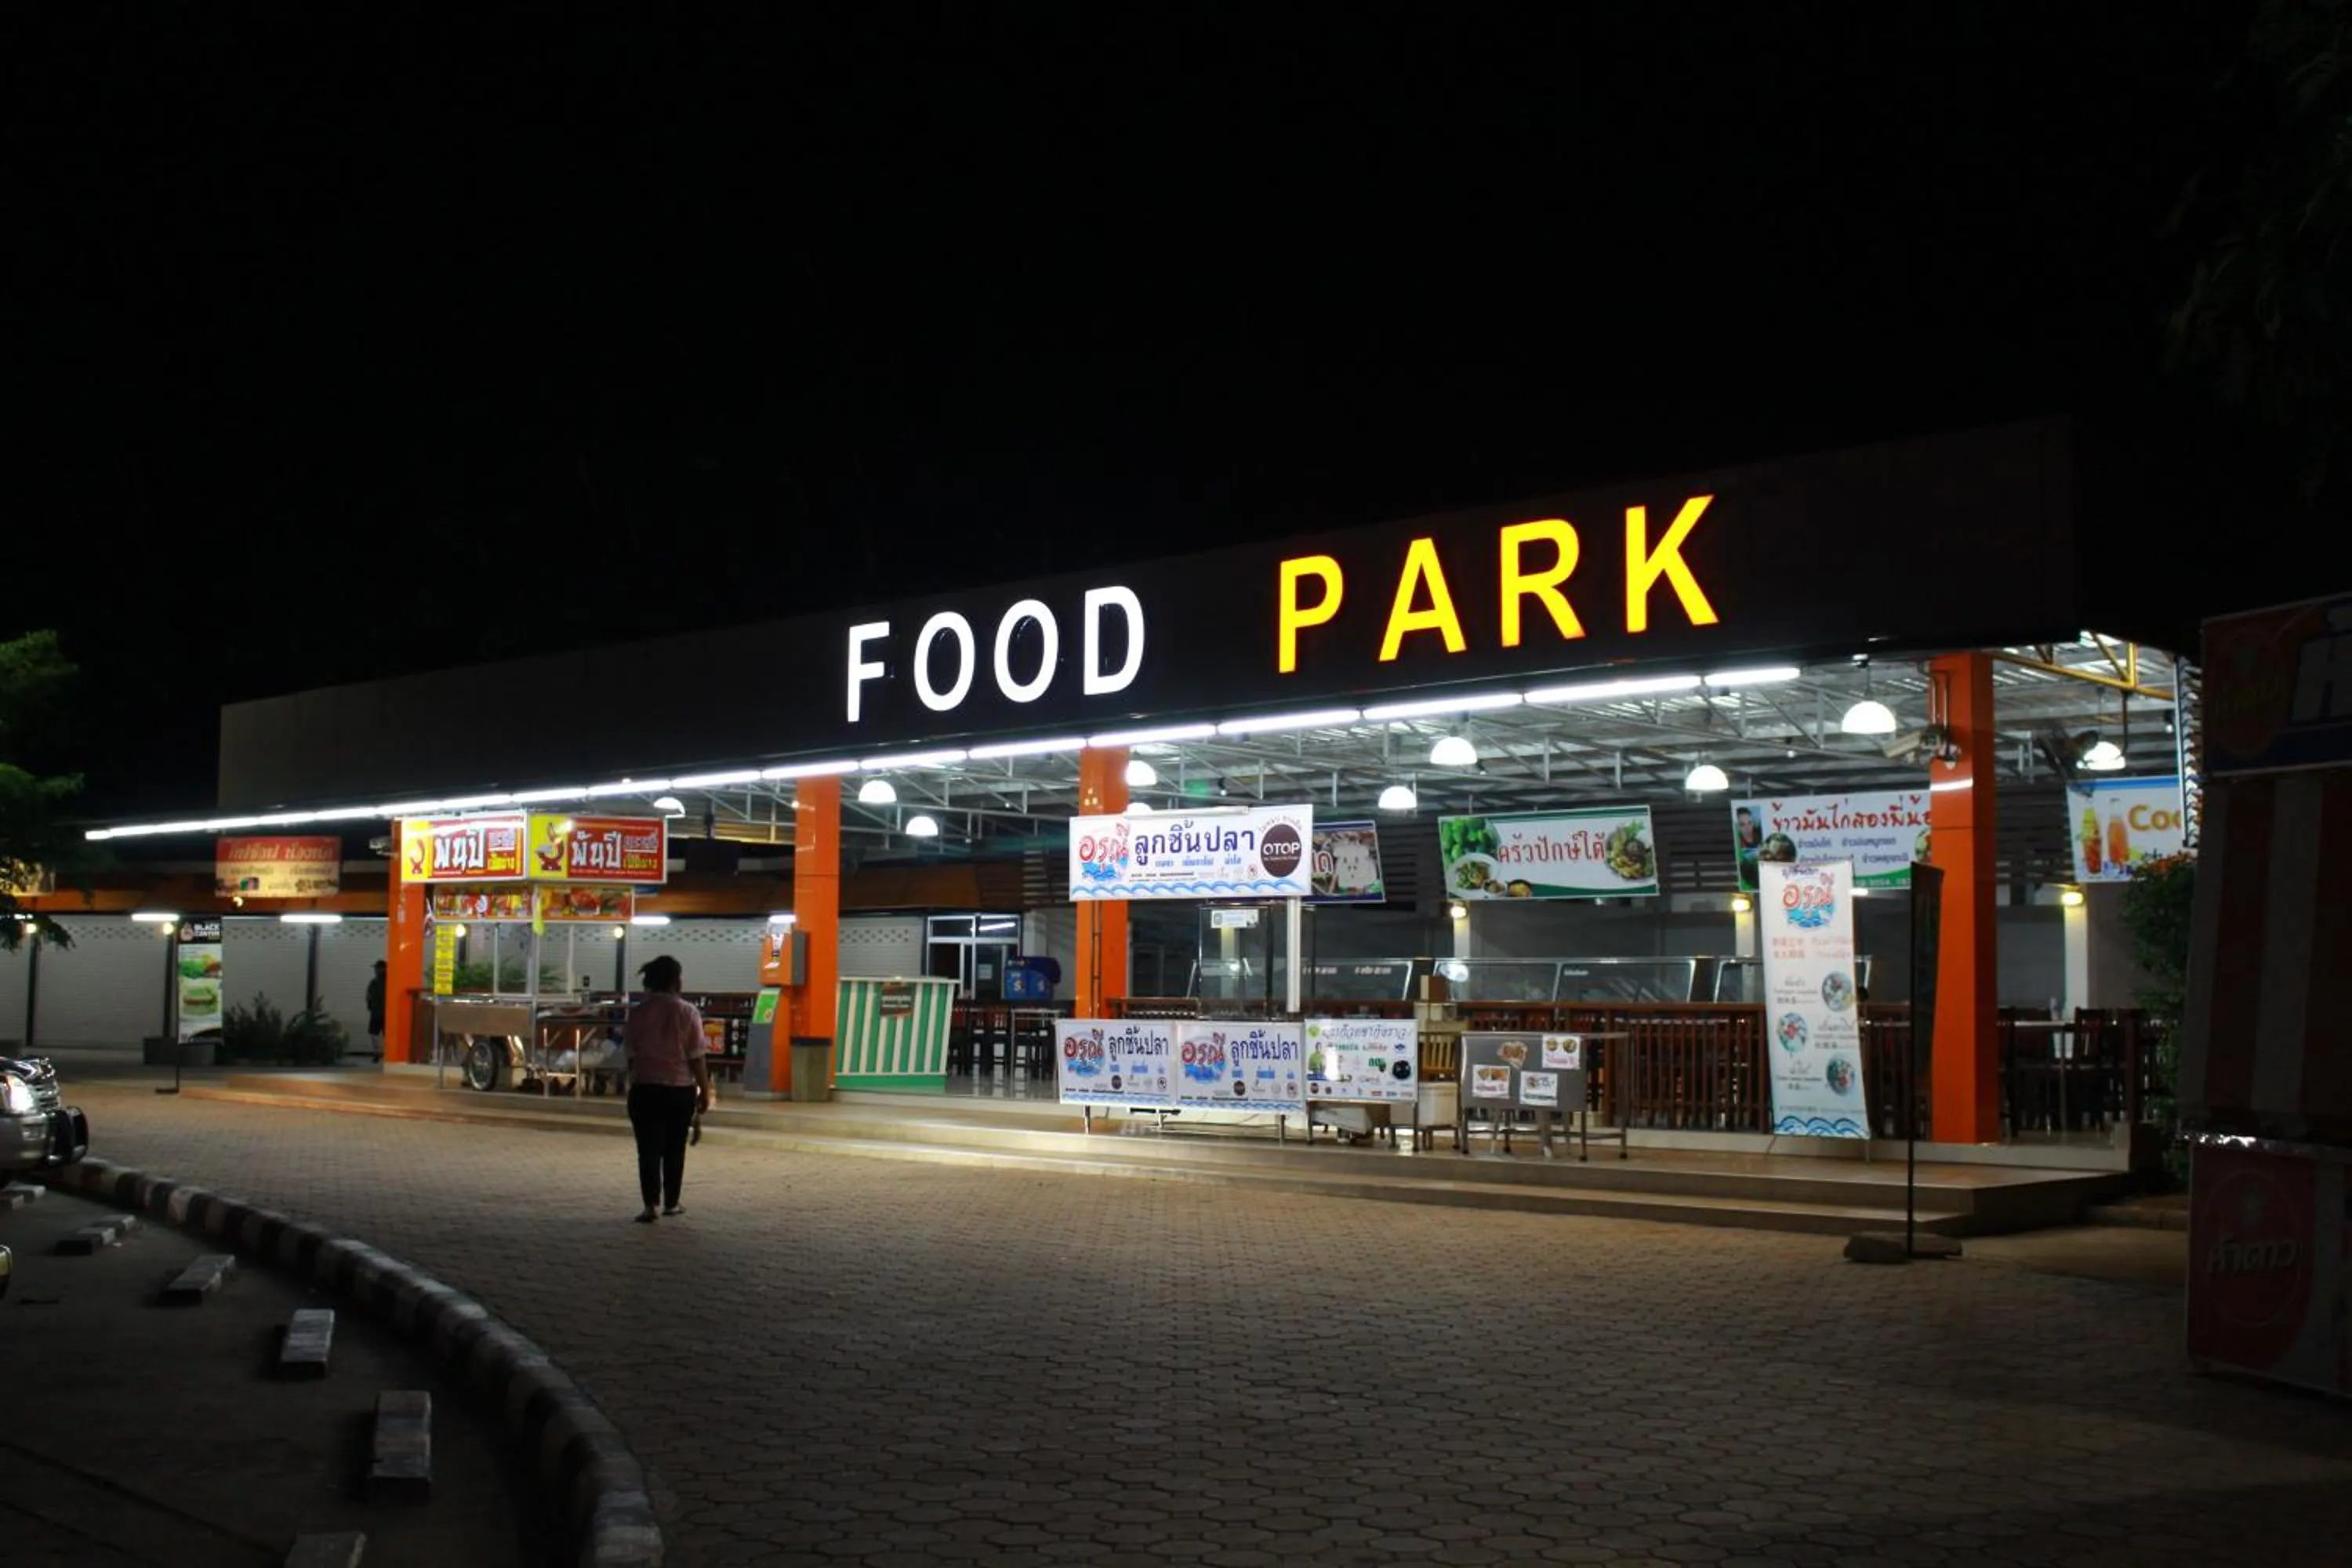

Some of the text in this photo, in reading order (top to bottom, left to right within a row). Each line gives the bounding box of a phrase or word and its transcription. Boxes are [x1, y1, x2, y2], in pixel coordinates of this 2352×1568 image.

[847, 494, 1720, 723] FOOD PARK
[570, 830, 622, 869] พันปี
[1134, 820, 1255, 866] ลูกชิ้นปลา
[1263, 842, 1301, 855] OTOP
[1496, 830, 1606, 863] ครัวปักษ์ใต้
[1108, 1027, 1169, 1062] ลูกชิ้นปลา
[1230, 1029, 1299, 1066] ลูกชิ้นปลา
